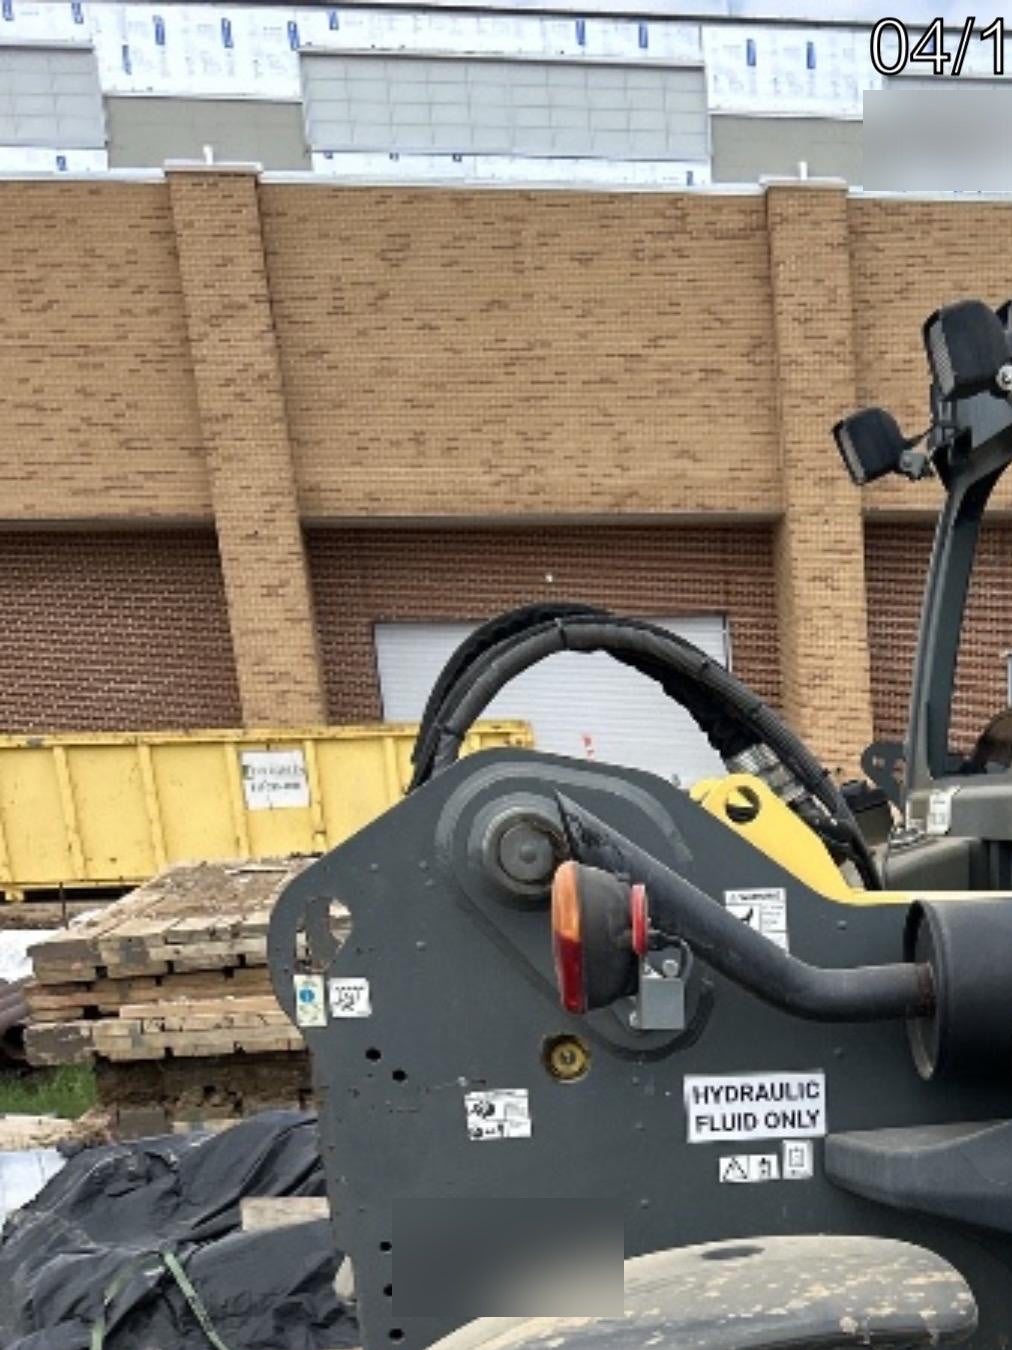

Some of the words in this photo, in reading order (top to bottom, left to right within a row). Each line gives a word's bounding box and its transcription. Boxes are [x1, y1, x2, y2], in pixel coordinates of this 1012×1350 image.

[692, 1080, 820, 1104] HYDRAULIC
[695, 1112, 758, 1133] FLUID
[763, 1109, 820, 1129] ONLY
